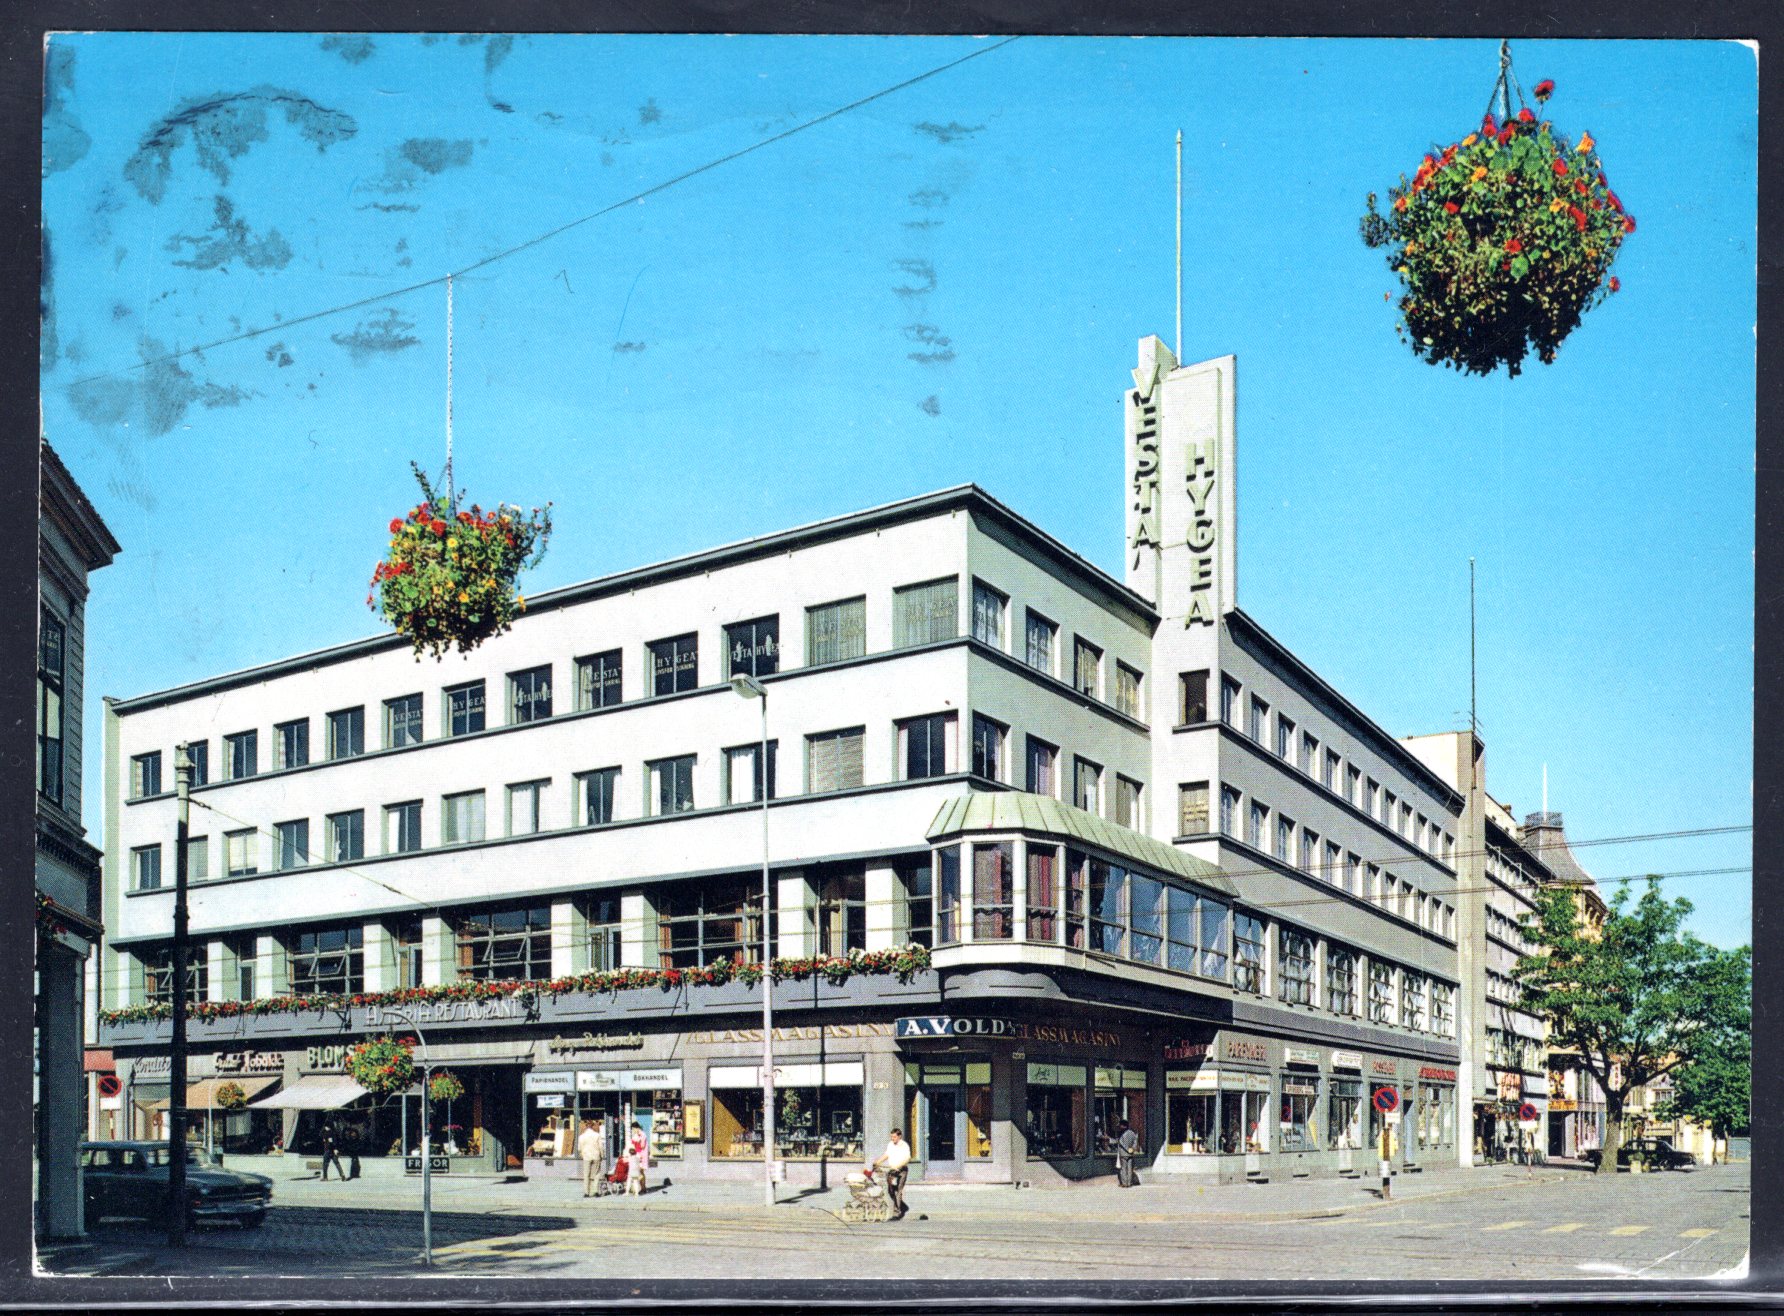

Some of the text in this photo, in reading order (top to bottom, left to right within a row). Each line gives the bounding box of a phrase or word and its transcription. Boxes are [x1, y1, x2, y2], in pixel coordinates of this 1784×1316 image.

[1132, 364, 1160, 550] VESTA
[1184, 437, 1215, 629] HYGEA
[657, 651, 696, 668] HYGEA
[436, 999, 519, 1022] RESTAURANT
[307, 1044, 355, 1065] BLOMS
[408, 1159, 448, 1168] FRØR
